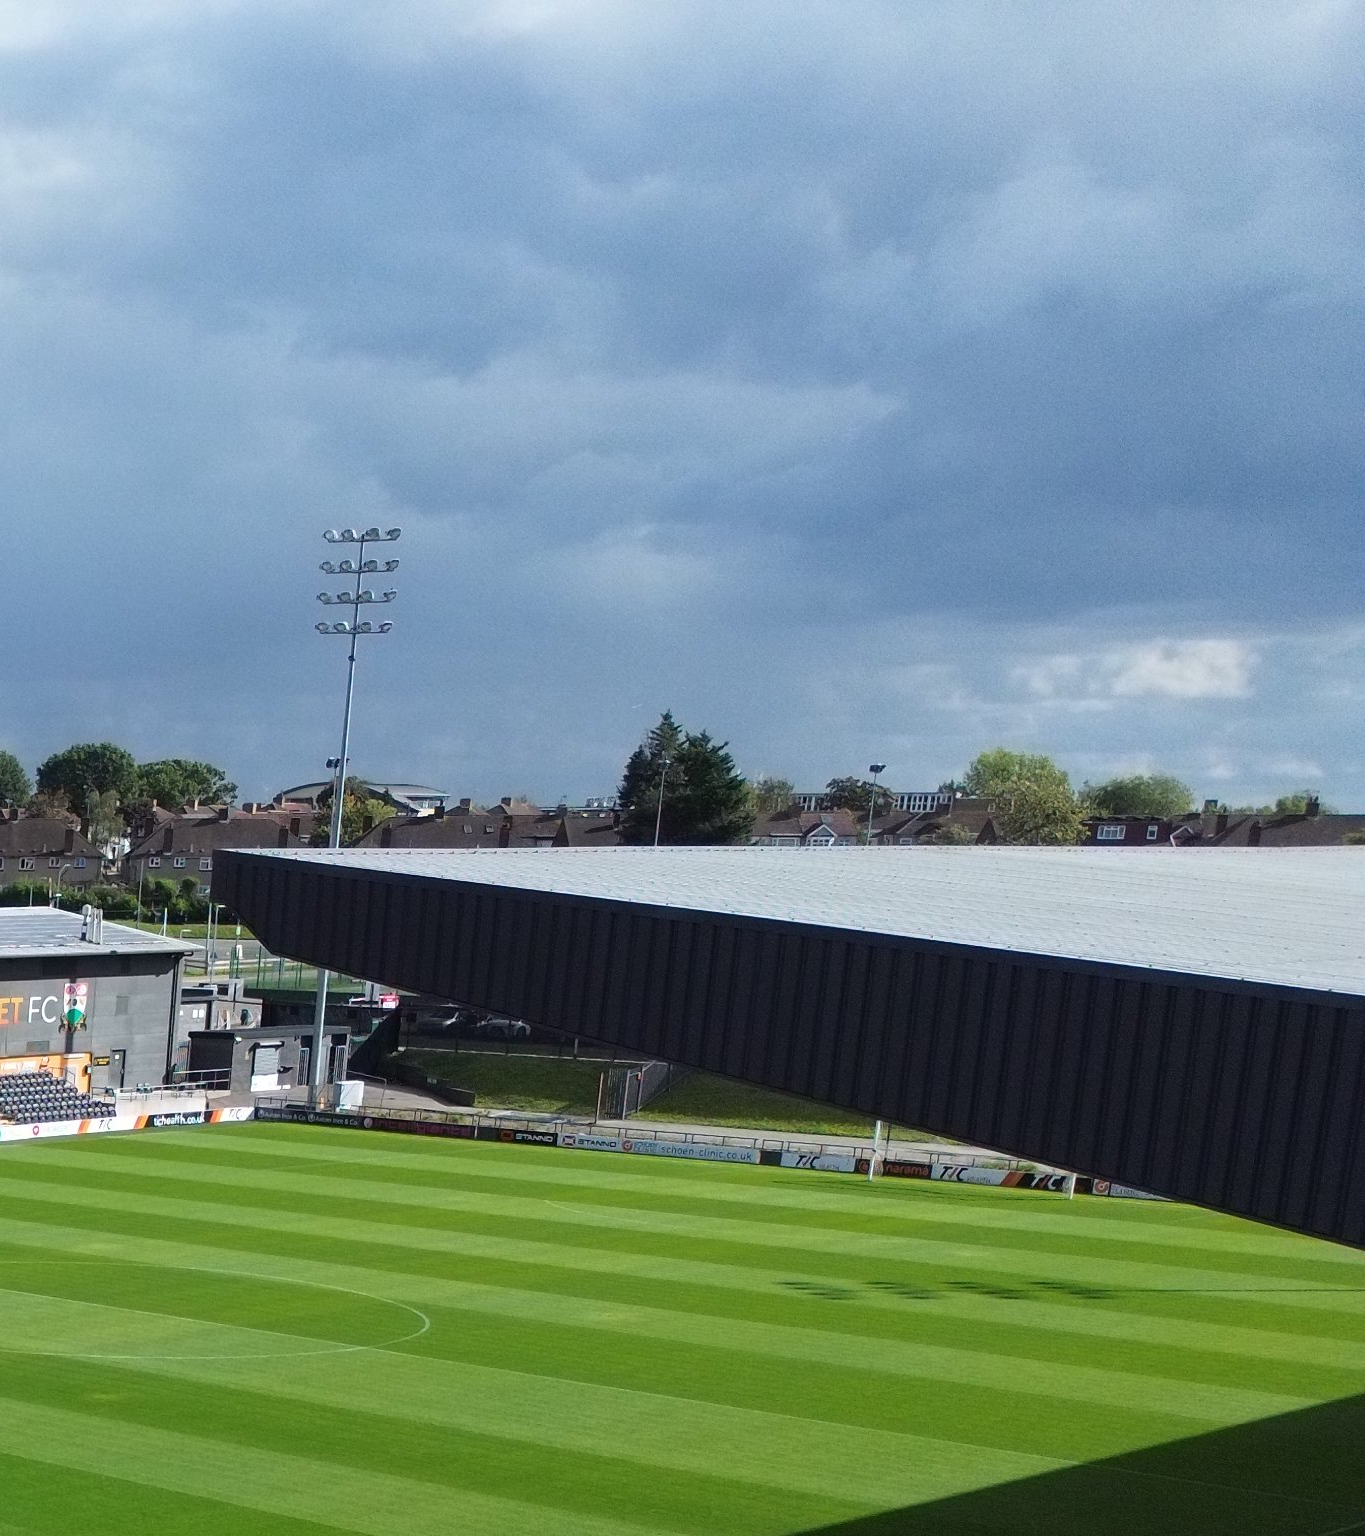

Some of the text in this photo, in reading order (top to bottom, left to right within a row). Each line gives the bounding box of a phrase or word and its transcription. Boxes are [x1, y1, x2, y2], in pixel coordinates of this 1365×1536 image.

[28, 995, 59, 1024] FC
[515, 1132, 554, 1143] STANNO
[577, 1137, 617, 1148] STANNO
